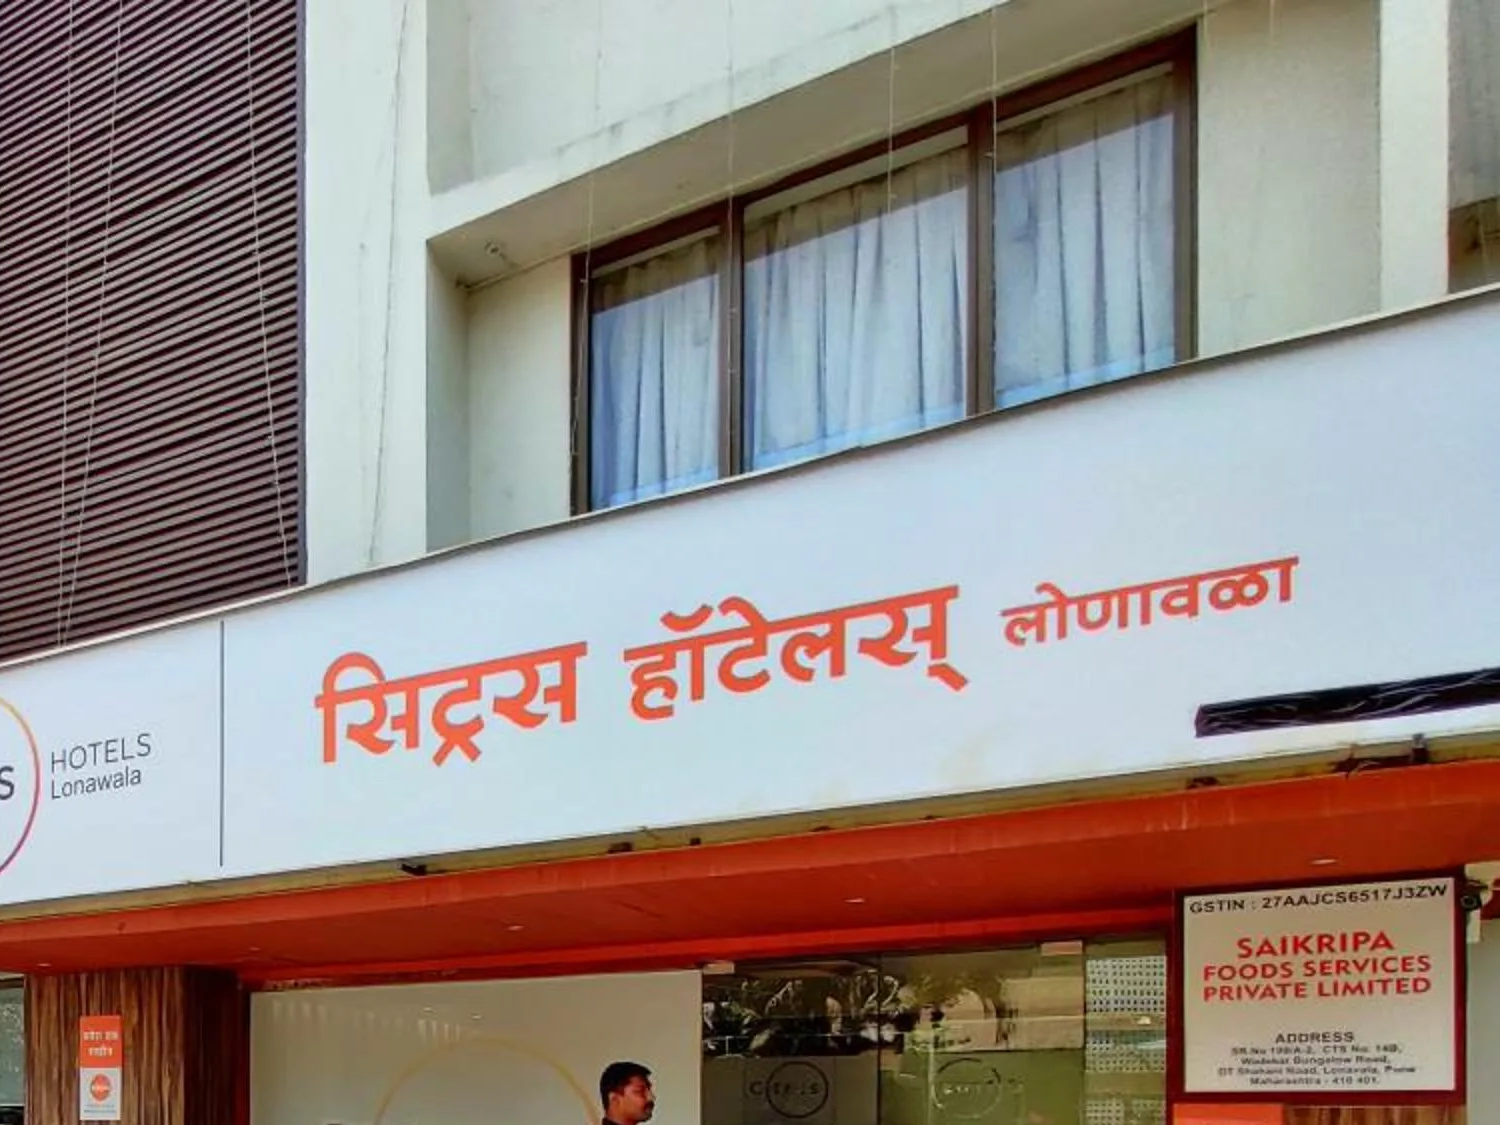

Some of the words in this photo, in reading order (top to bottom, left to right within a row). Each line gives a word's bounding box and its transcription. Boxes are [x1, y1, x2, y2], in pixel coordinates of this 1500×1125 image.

[314, 640, 588, 767] सिट्रस
[623, 584, 970, 721] हॉटेलस्
[1000, 556, 1299, 646] लोणावळा
[51, 733, 151, 773] HOTELS
[51, 766, 141, 800] Lonawala
[1189, 899, 1245, 914] GSTIN
[1237, 930, 1394, 959] SAIKRIPA
[1203, 962, 1293, 982] FOODS
[1303, 955, 1431, 978] SERVICES
[1203, 982, 1308, 1003] PRIVATE
[1317, 977, 1431, 998] LIMITED
[1275, 1032, 1354, 1043] ADDRESS
